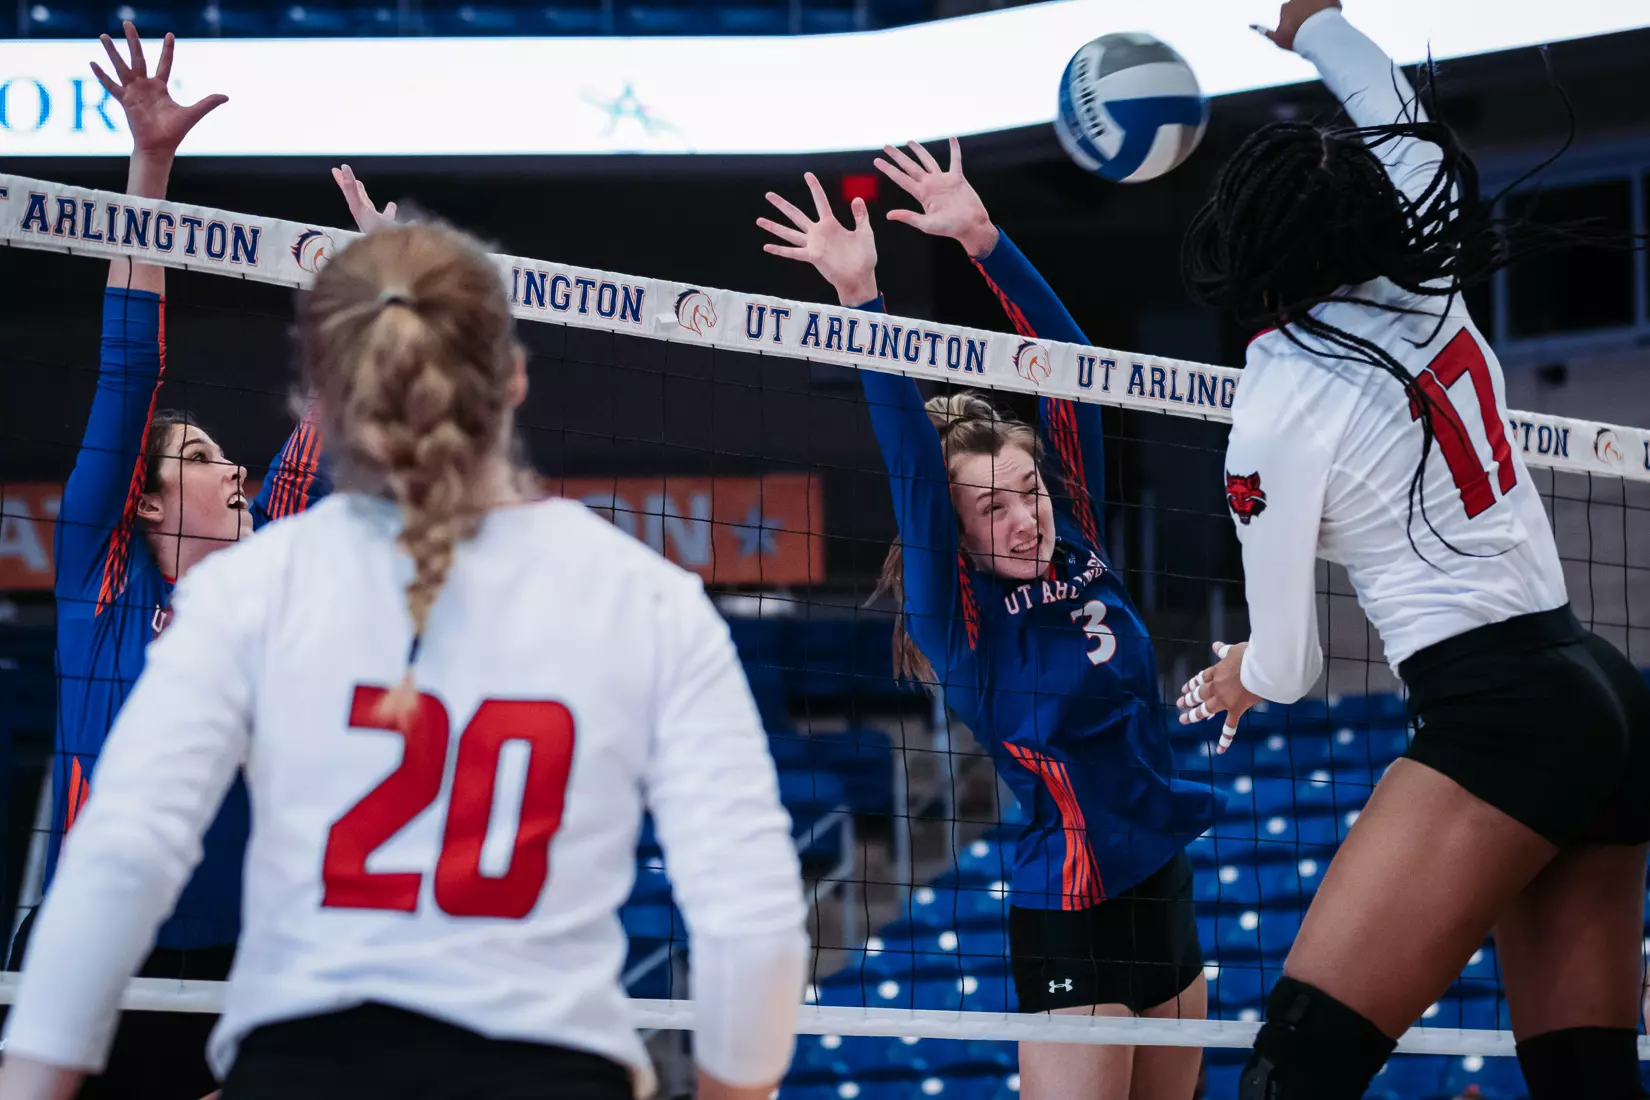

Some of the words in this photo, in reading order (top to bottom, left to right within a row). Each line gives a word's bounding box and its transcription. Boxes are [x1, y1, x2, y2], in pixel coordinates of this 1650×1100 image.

[21, 191, 262, 267] ARLINGTON
[745, 302, 791, 344] UT
[800, 311, 988, 375] ARLINGTON
[1076, 353, 1118, 393] UT
[1126, 361, 1240, 411] ARLING
[1404, 326, 1518, 520] 17
[1003, 583, 1034, 616] UT
[1069, 599, 1117, 668] 3
[320, 683, 576, 919] 20
